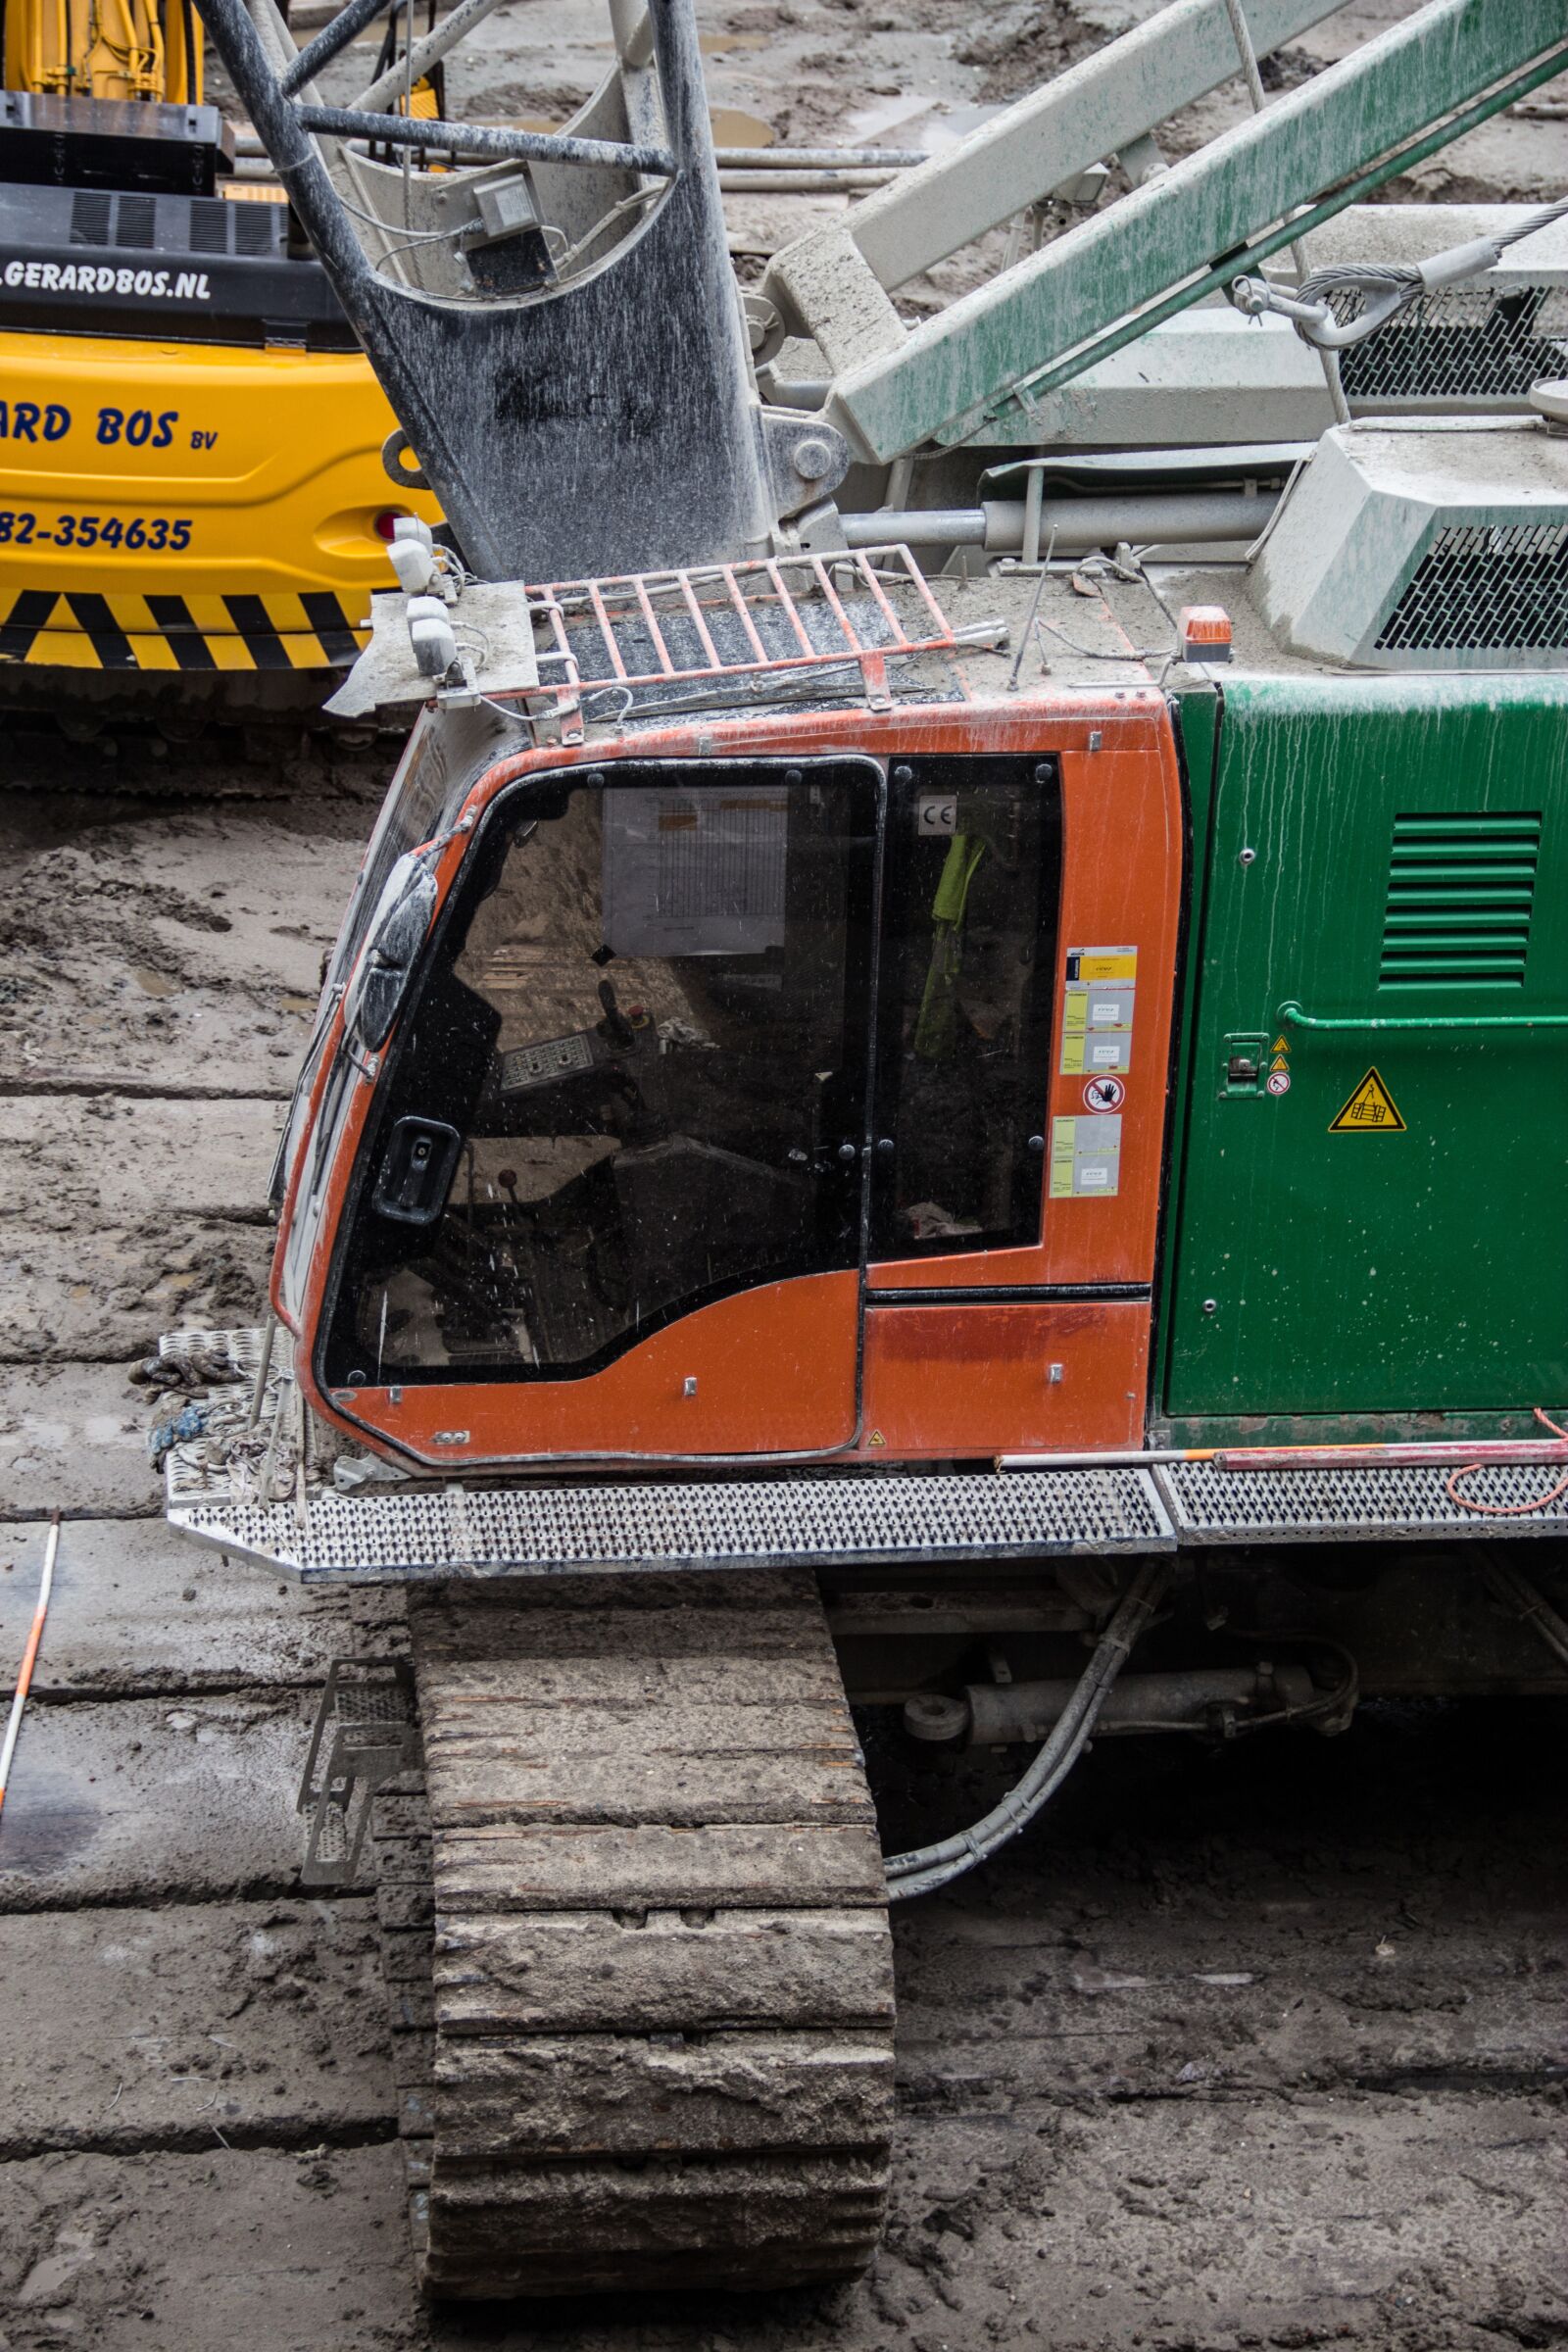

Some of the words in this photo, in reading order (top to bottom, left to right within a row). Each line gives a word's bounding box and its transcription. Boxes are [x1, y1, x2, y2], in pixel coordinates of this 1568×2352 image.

[96, 408, 179, 448] BOS
[190, 430, 219, 450] BV
[0, 512, 193, 551] 82-354635
[924, 806, 953, 825] CE
